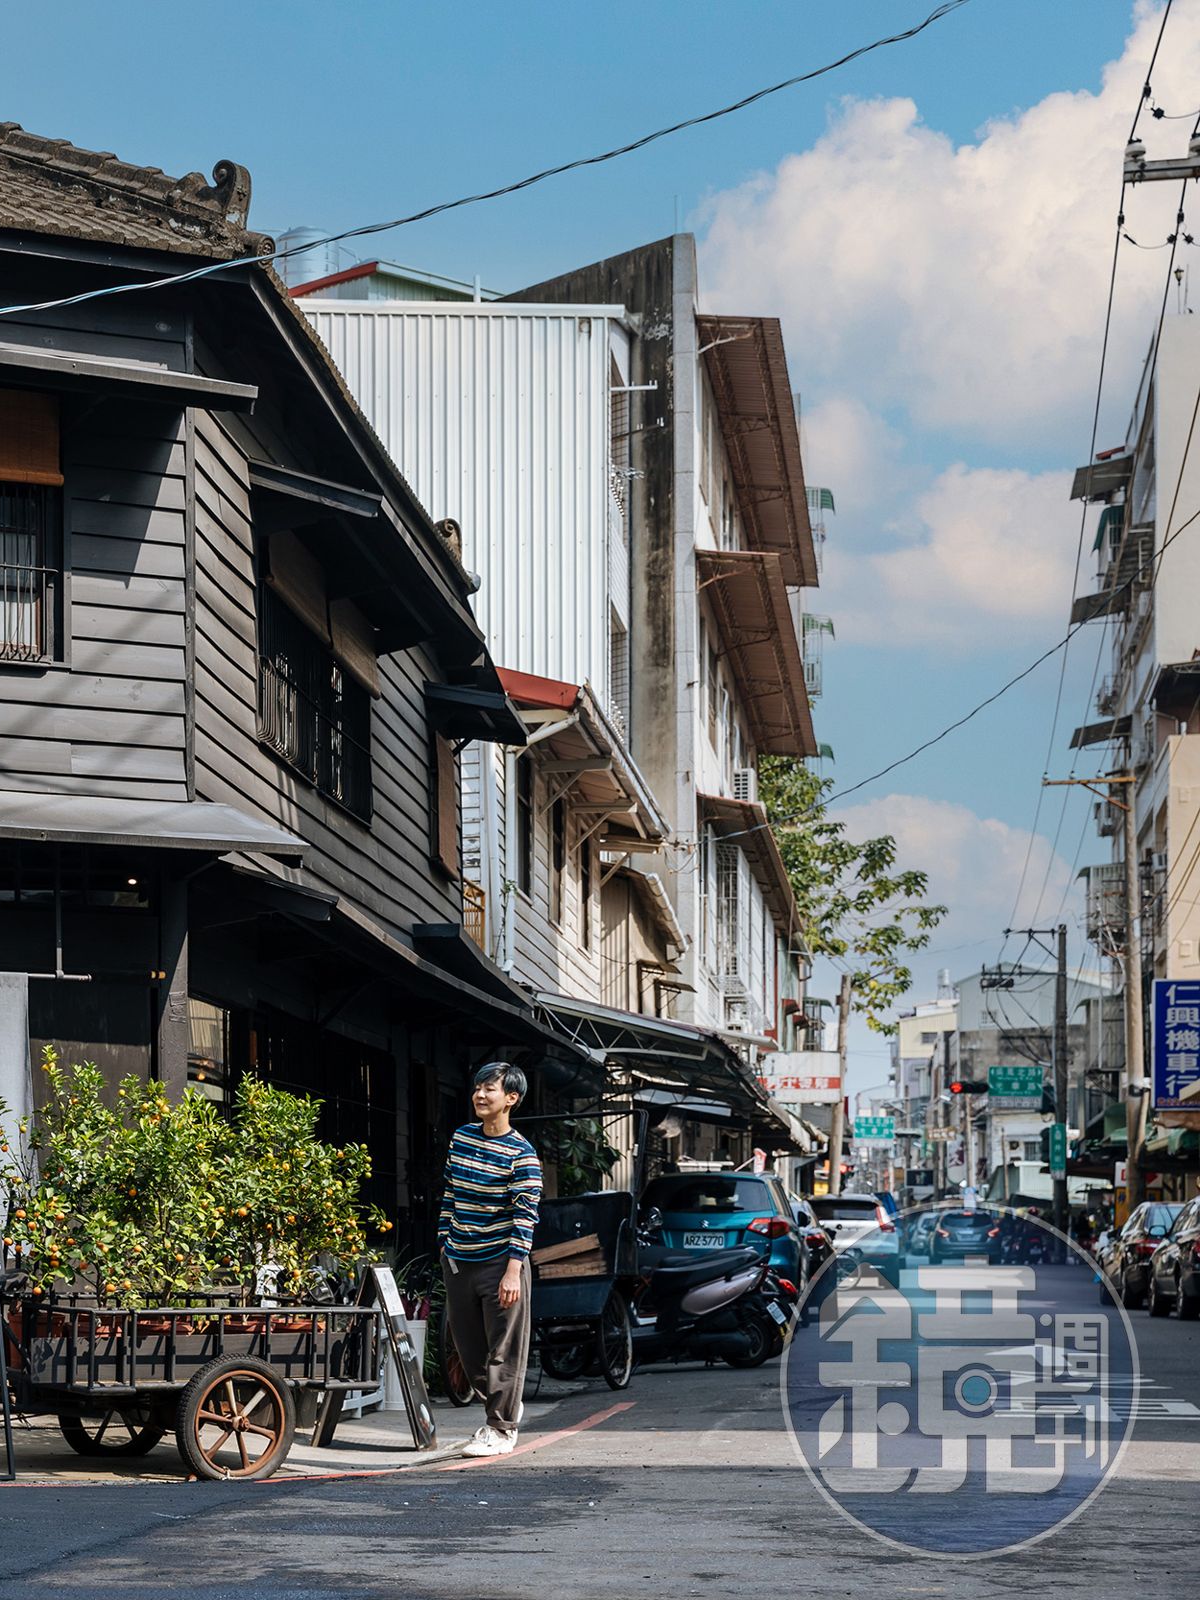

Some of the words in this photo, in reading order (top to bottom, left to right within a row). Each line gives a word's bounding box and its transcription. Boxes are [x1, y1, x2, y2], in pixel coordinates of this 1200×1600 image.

[1165, 984, 1200, 1096] 仁興機車行
